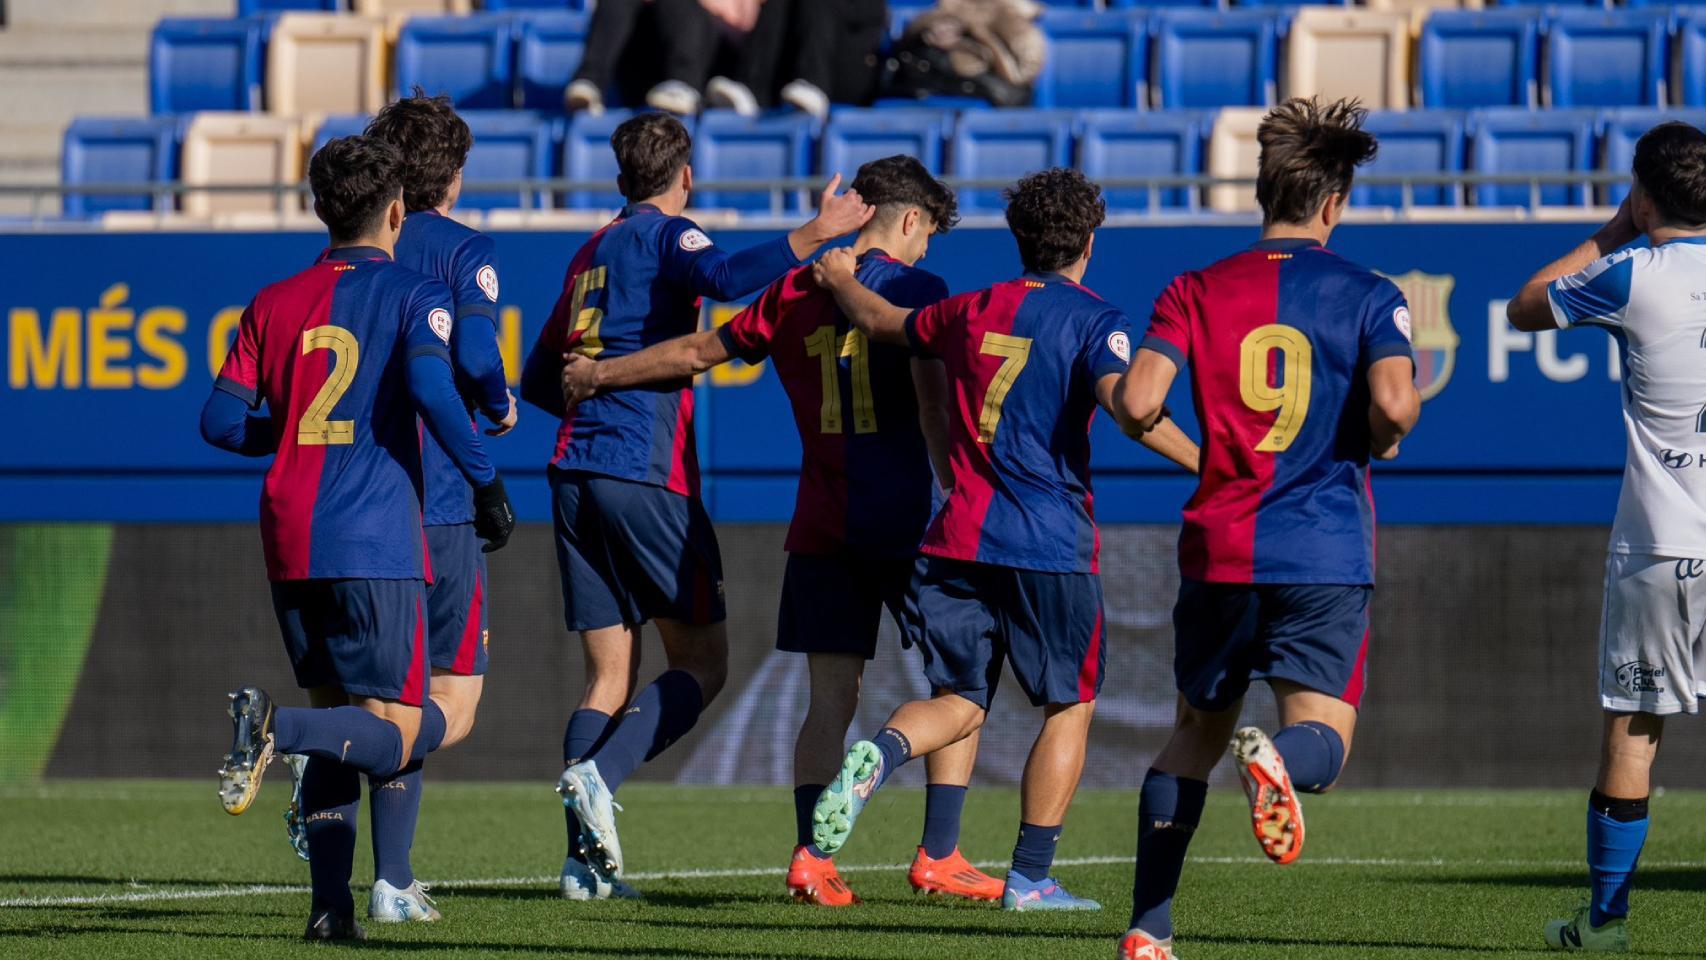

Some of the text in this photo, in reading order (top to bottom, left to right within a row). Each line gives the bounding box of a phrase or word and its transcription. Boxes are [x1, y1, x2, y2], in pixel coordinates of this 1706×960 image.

[8, 282, 188, 390] MÉS
[298, 324, 359, 446] 2
[803, 325, 879, 435] 11
[976, 331, 1034, 444] 7
[1239, 323, 1313, 453] 9
